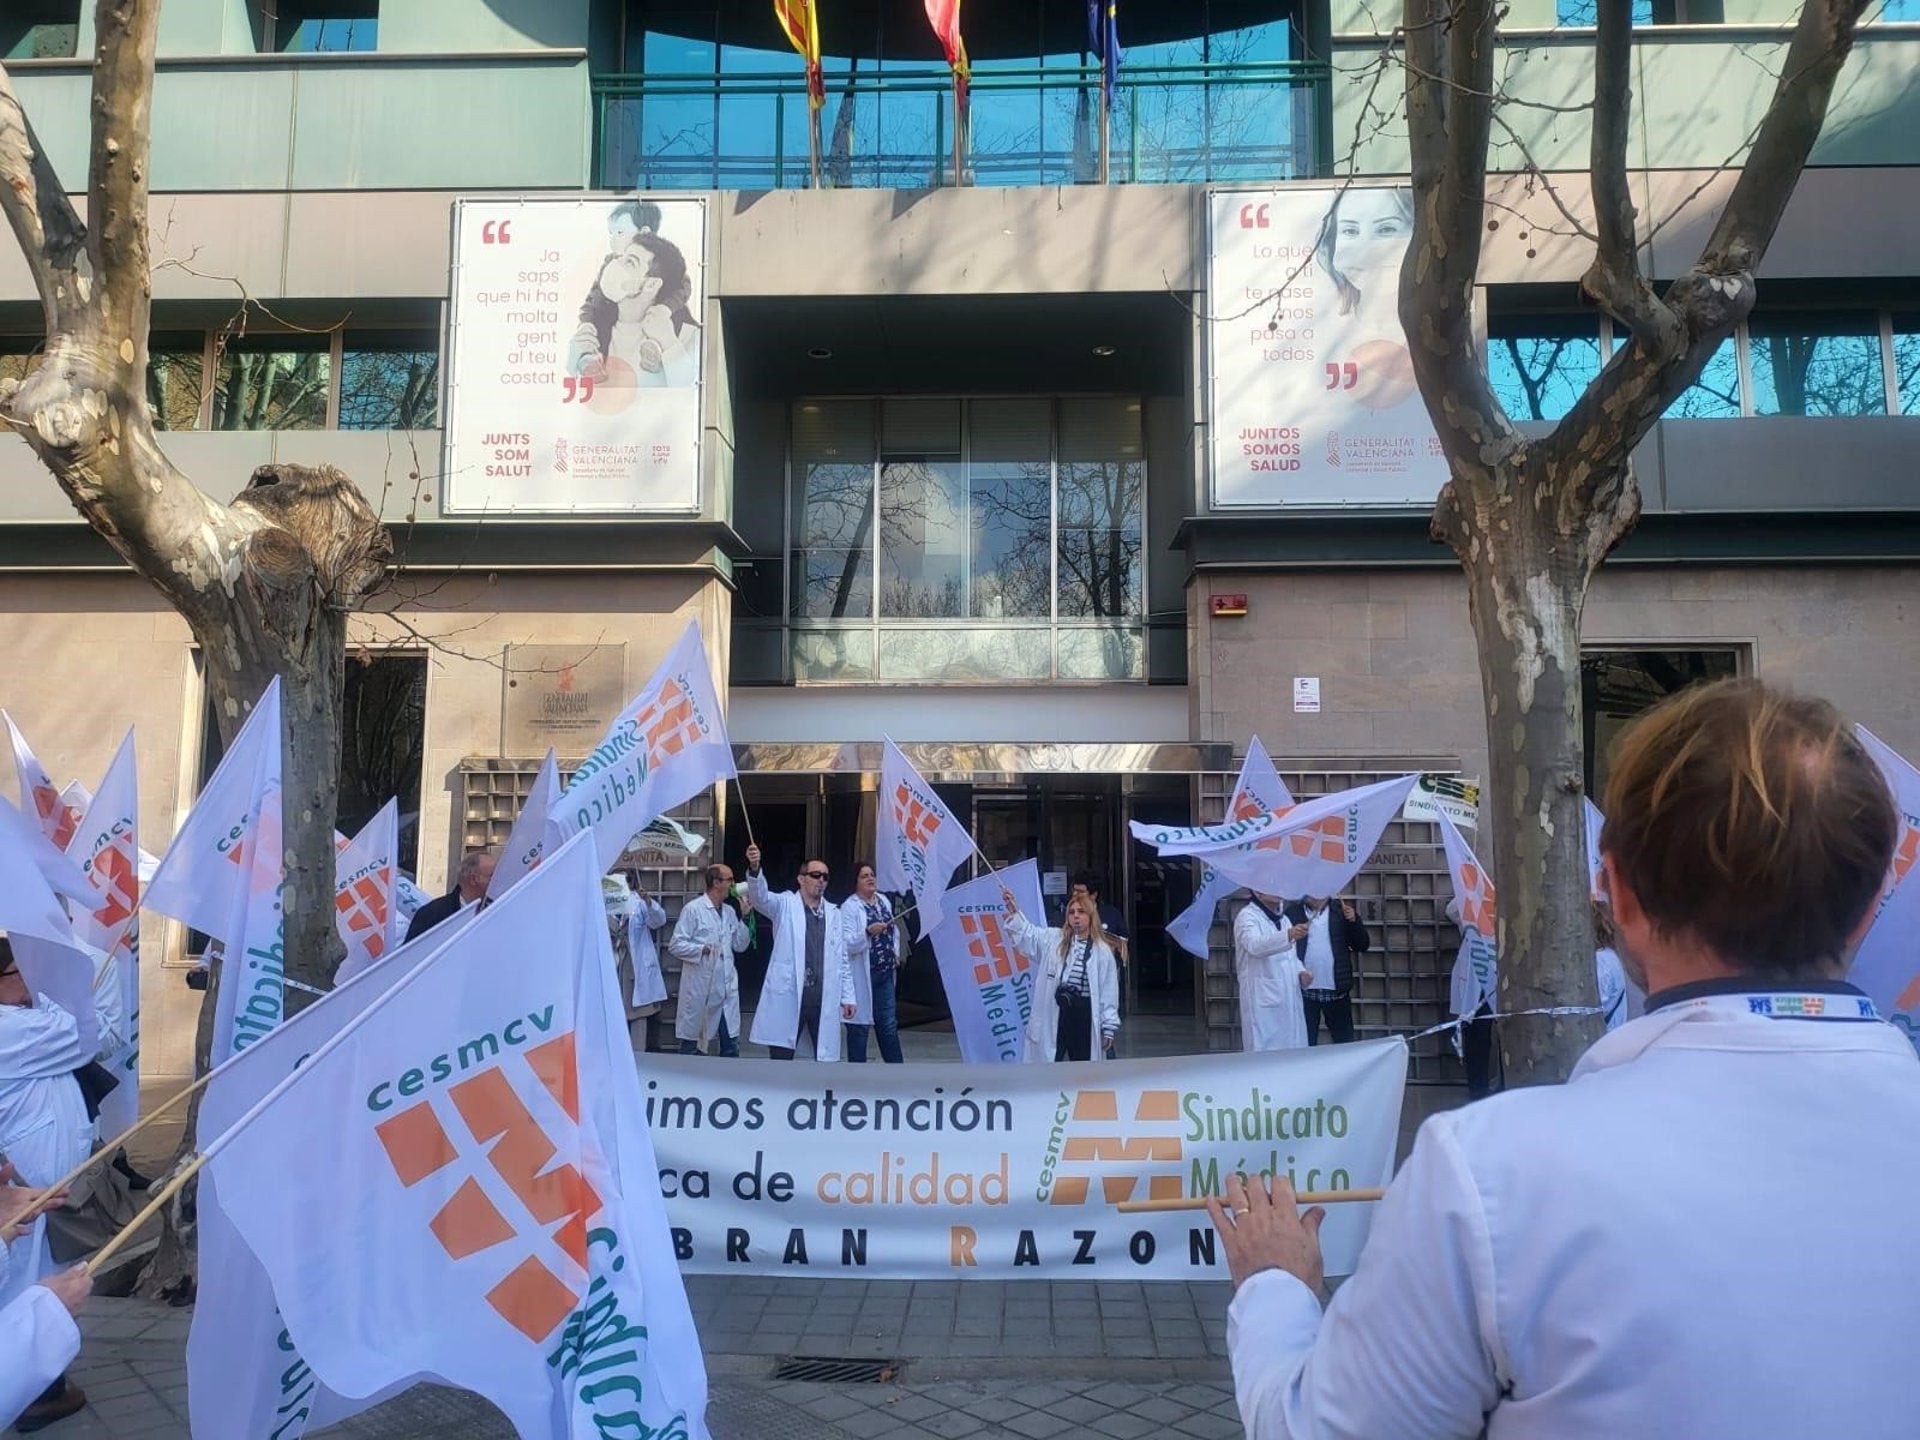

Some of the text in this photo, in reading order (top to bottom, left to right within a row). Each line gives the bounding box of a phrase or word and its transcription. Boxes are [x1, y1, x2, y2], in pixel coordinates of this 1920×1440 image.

[539, 249, 560, 263] Ja
[1253, 244, 1272, 259] Lo
[1302, 262, 1313, 278] ti
[517, 270, 560, 287] saps
[476, 289, 559, 307] que hi ha
[1245, 286, 1263, 300] te
[506, 309, 558, 323] molta
[1282, 307, 1314, 320] nos
[517, 331, 557, 348] gent
[1250, 328, 1314, 345] pasa a
[507, 350, 557, 364] al teu
[1263, 346, 1315, 361] todos
[500, 371, 556, 385] costat
[481, 433, 530, 445] JUNTS
[1238, 427, 1301, 440] JUNTOS
[1242, 443, 1301, 456] SOMOS
[1344, 438, 1415, 447] GENERALITAT
[494, 449, 529, 461] SOM
[572, 445, 640, 455] GENERALITAT
[1345, 448, 1414, 458] VALENCIANA
[572, 455, 639, 465] VALENCIANA
[1250, 459, 1301, 472] SALUD
[485, 465, 532, 477] SALUT
[366, 1004, 555, 1112] cesmcv
[646, 1080, 1013, 1132] imos atención
[1182, 1087, 1349, 1142] Sindicato
[1036, 1091, 1071, 1202] cesmcv
[732, 1150, 795, 1202] de
[816, 1151, 1009, 1206] calidad
